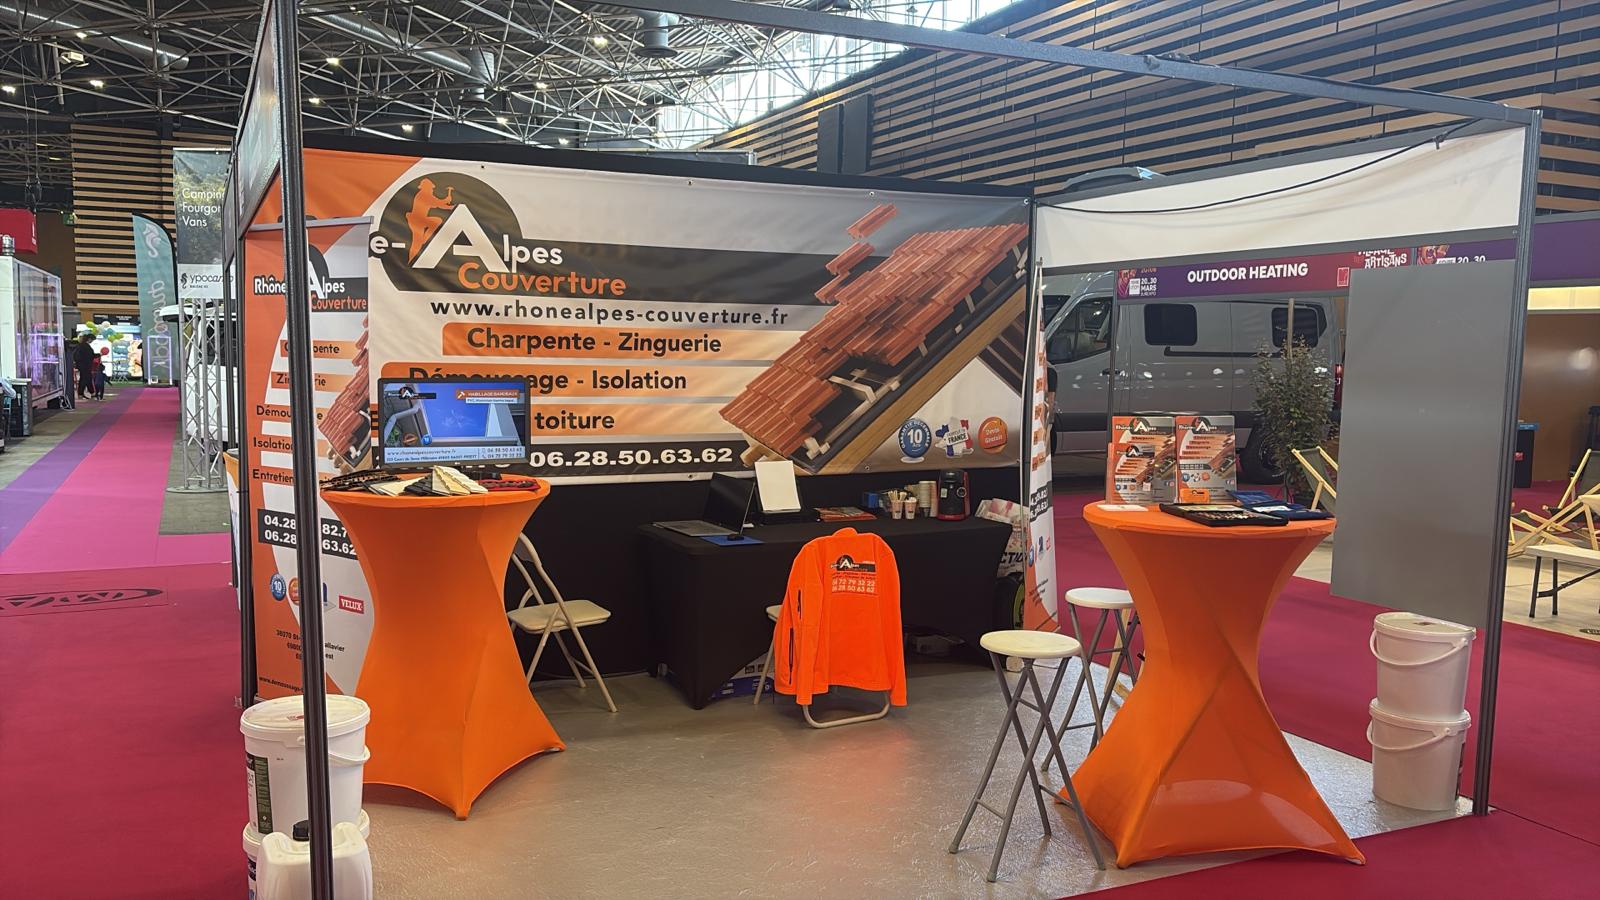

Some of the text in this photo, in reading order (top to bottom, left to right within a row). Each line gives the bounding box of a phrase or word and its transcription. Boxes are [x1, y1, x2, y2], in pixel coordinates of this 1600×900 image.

[182, 215, 208, 227] Vans
[1364, 253, 1408, 269] ARTISANS
[458, 262, 627, 296] Couverture
[1187, 262, 1309, 283] OUTDOOR HEATING
[1140, 284, 1157, 292] MARS
[310, 294, 367, 310] Couverture
[430, 300, 788, 326] www.rhonealpes-couverture.fr
[467, 327, 596, 354] Charpente
[617, 332, 722, 357] Zinguerie
[592, 369, 686, 390] Isolation
[535, 411, 615, 430] toiture
[907, 428, 923, 445] 10
[948, 432, 967, 444] FRANCE
[529, 447, 733, 469] 06.28.50.63.62
[340, 598, 362, 611] VELUX
